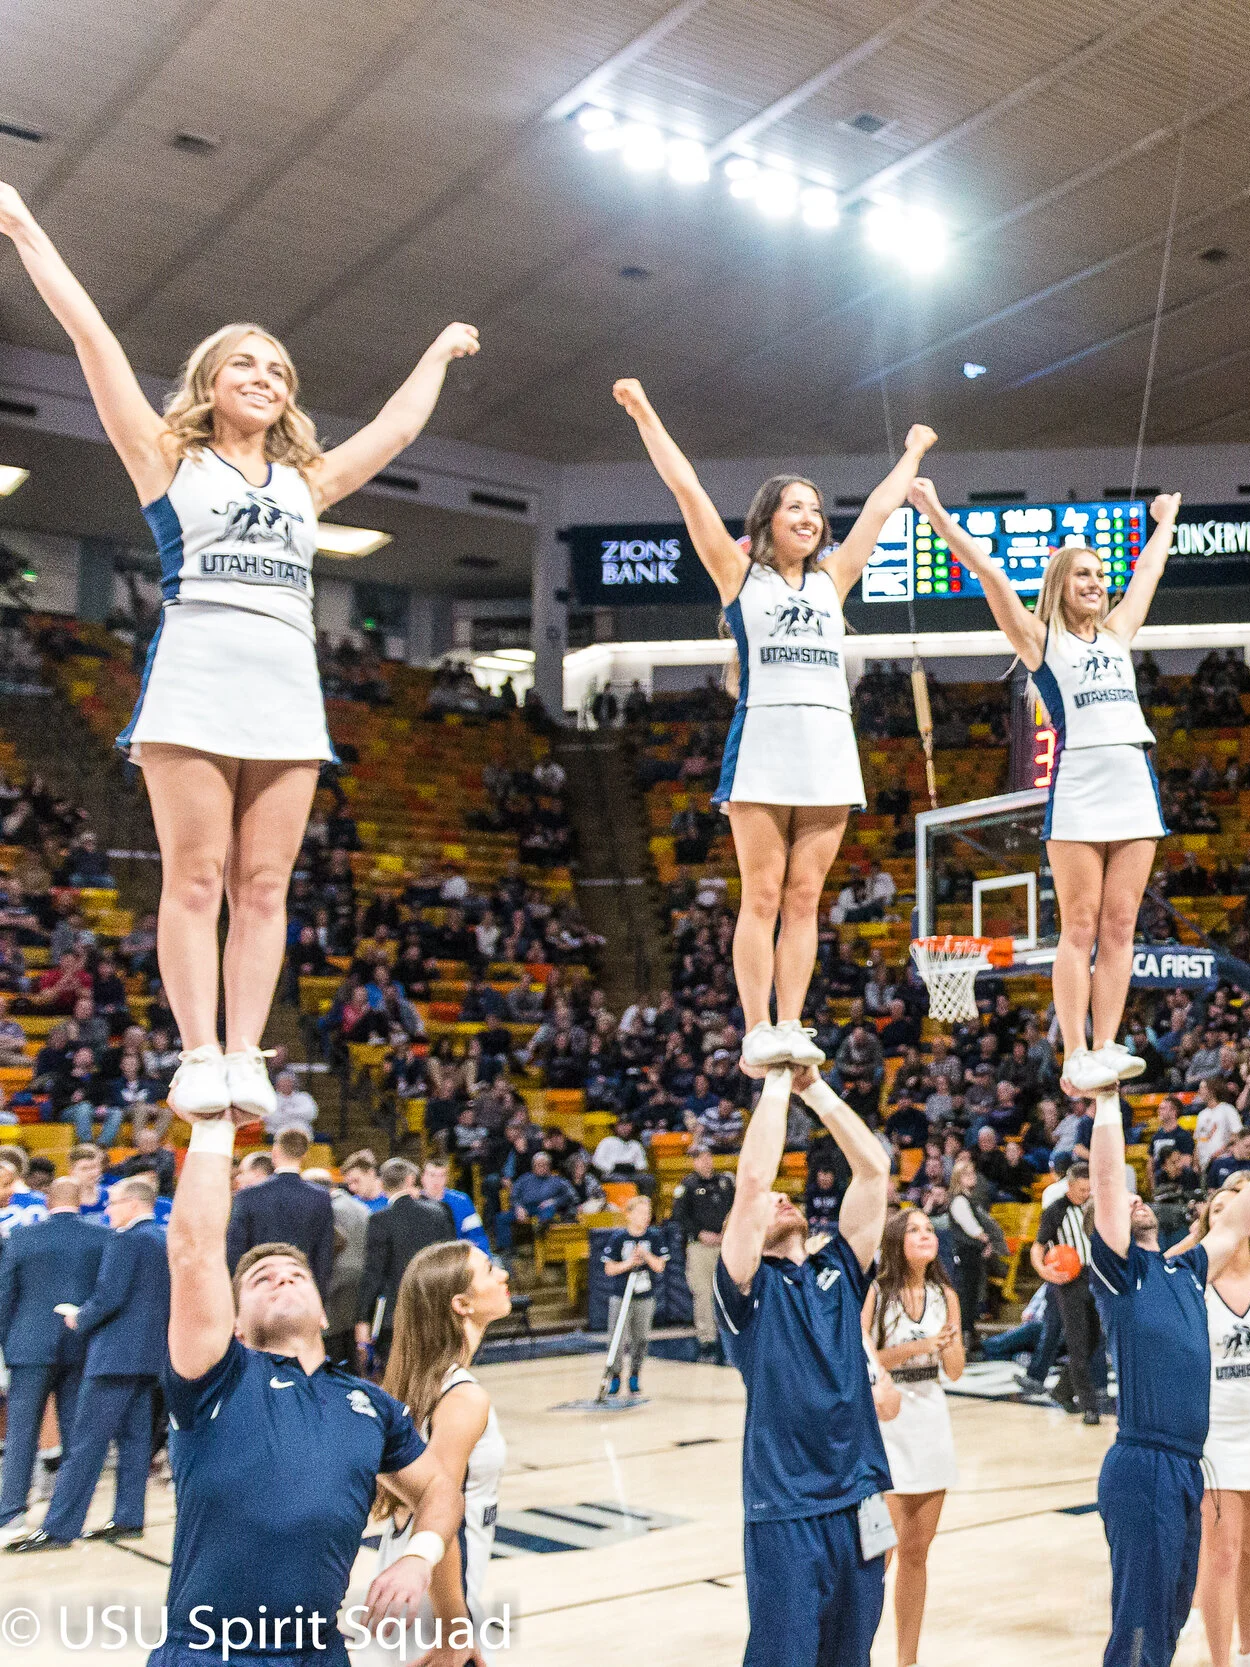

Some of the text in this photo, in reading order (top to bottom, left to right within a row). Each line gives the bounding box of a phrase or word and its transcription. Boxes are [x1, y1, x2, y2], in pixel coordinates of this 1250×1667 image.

[601, 538, 681, 561] ZIONS
[200, 553, 311, 588] UTAH STATE
[602, 561, 679, 585] BANK
[759, 644, 839, 669] UTAH STATE
[1131, 953, 1215, 978] CA FIRST
